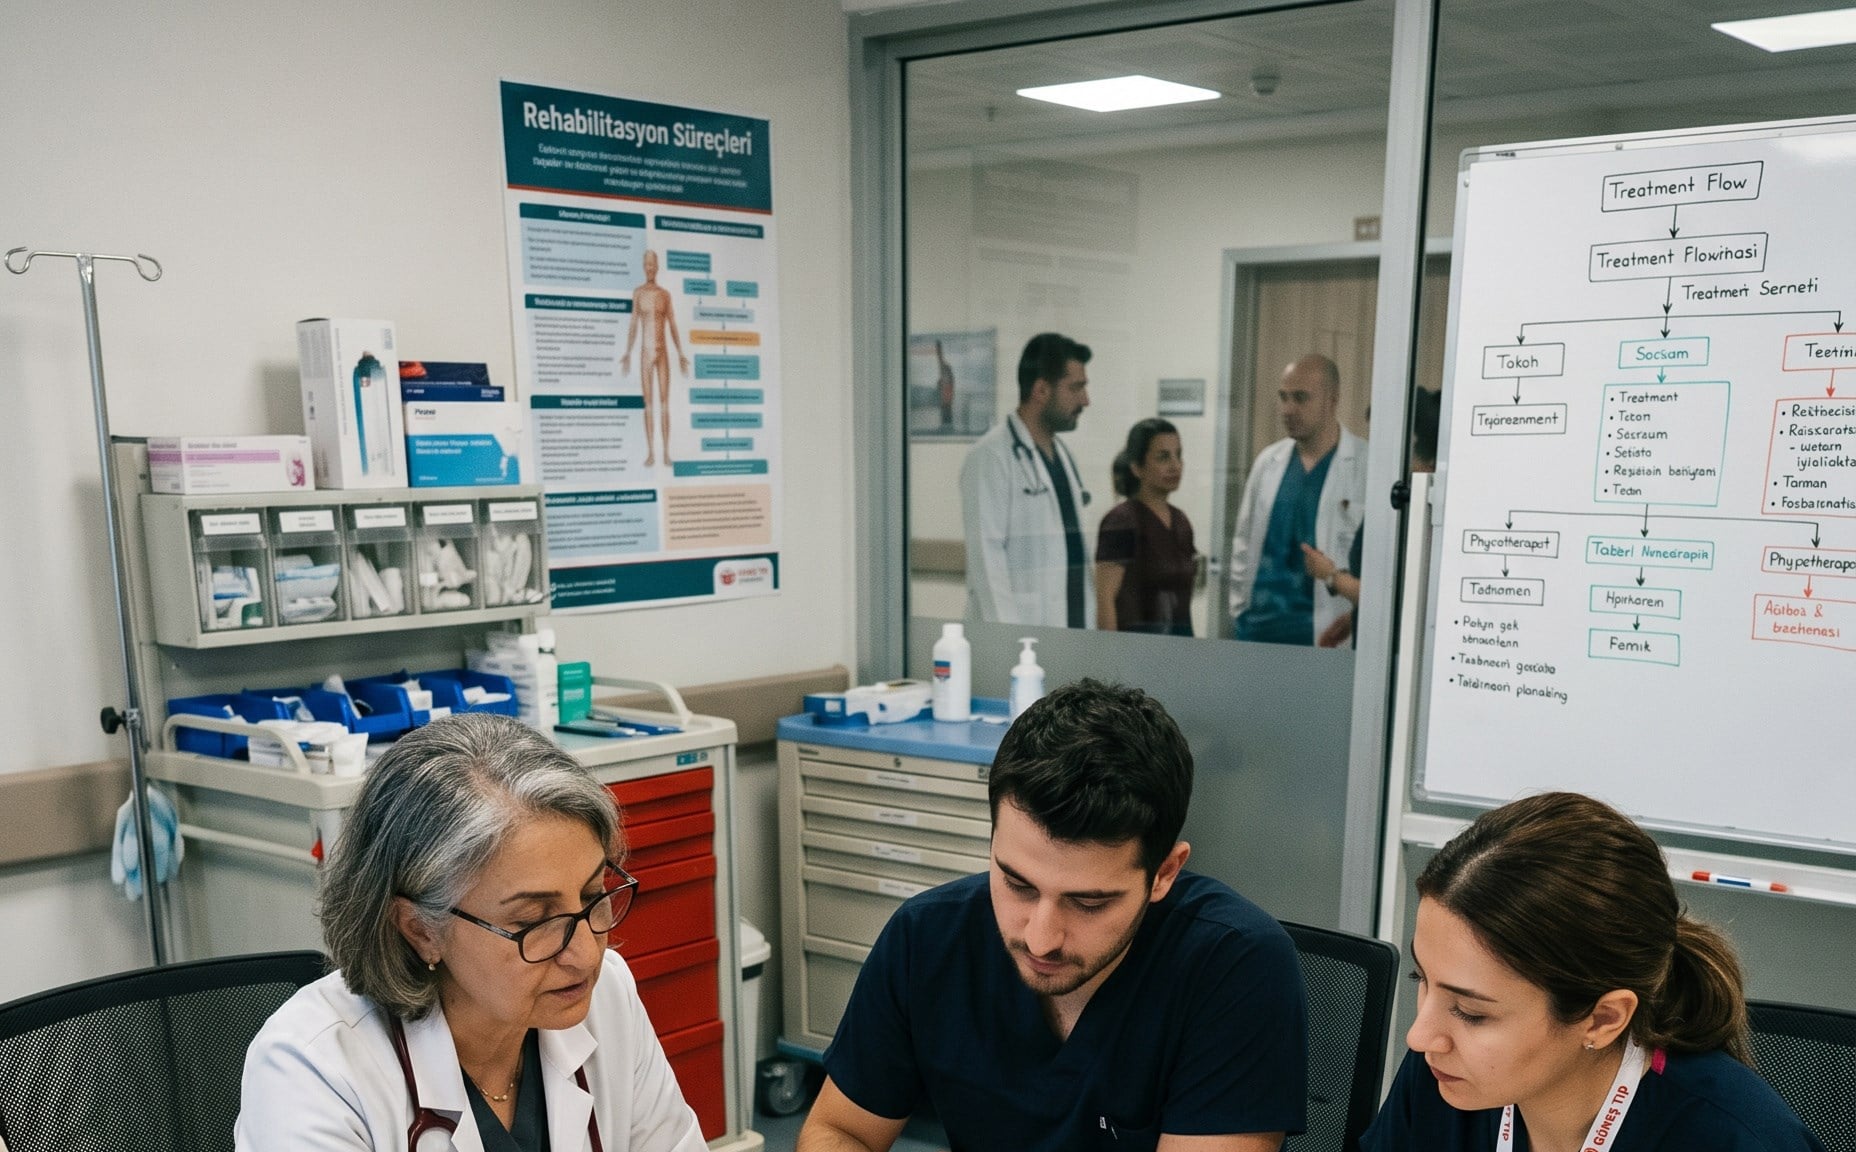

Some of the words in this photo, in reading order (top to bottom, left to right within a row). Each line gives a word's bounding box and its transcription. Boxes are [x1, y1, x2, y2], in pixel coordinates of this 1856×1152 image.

[522, 101, 668, 147] Rehabilitasyon
[673, 122, 752, 158] Süreçleri
[1609, 176, 1695, 199] Treatment
[1707, 173, 1747, 192] Flow
[1597, 249, 1675, 269] Treatment
[1619, 391, 1679, 403] Treatment
[1612, 1085, 1629, 1105] TIP
